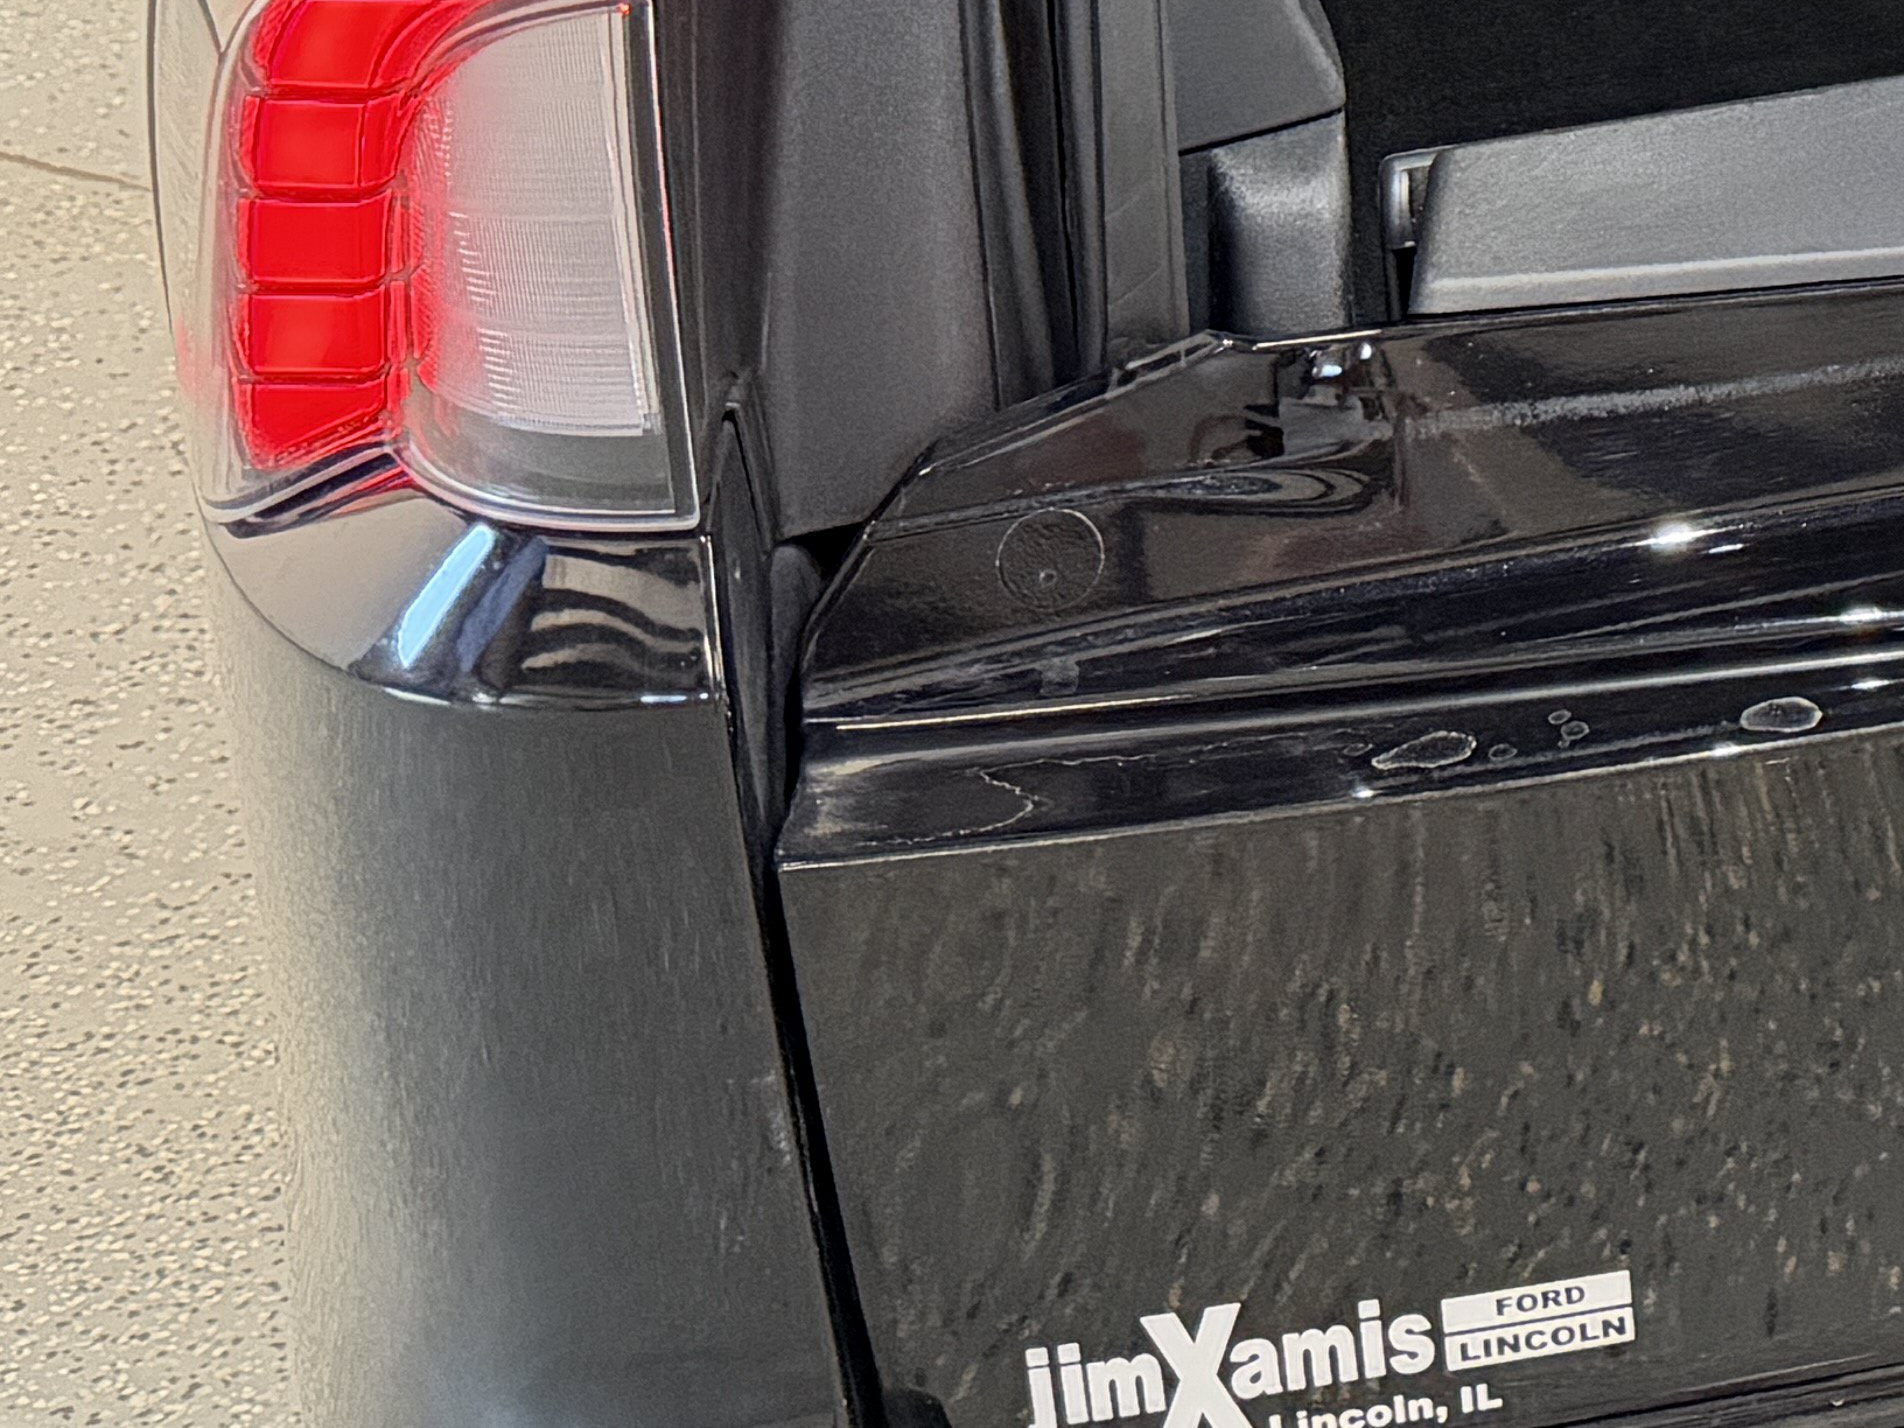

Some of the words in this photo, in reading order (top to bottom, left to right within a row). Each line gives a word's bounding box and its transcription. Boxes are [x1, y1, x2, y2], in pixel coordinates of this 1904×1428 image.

[1495, 1285, 1586, 1317] FORD
[1459, 1316, 1627, 1362] LINCOLN
[1025, 1298, 1436, 1428] jimXamis
[1460, 1383, 1504, 1415] IL
